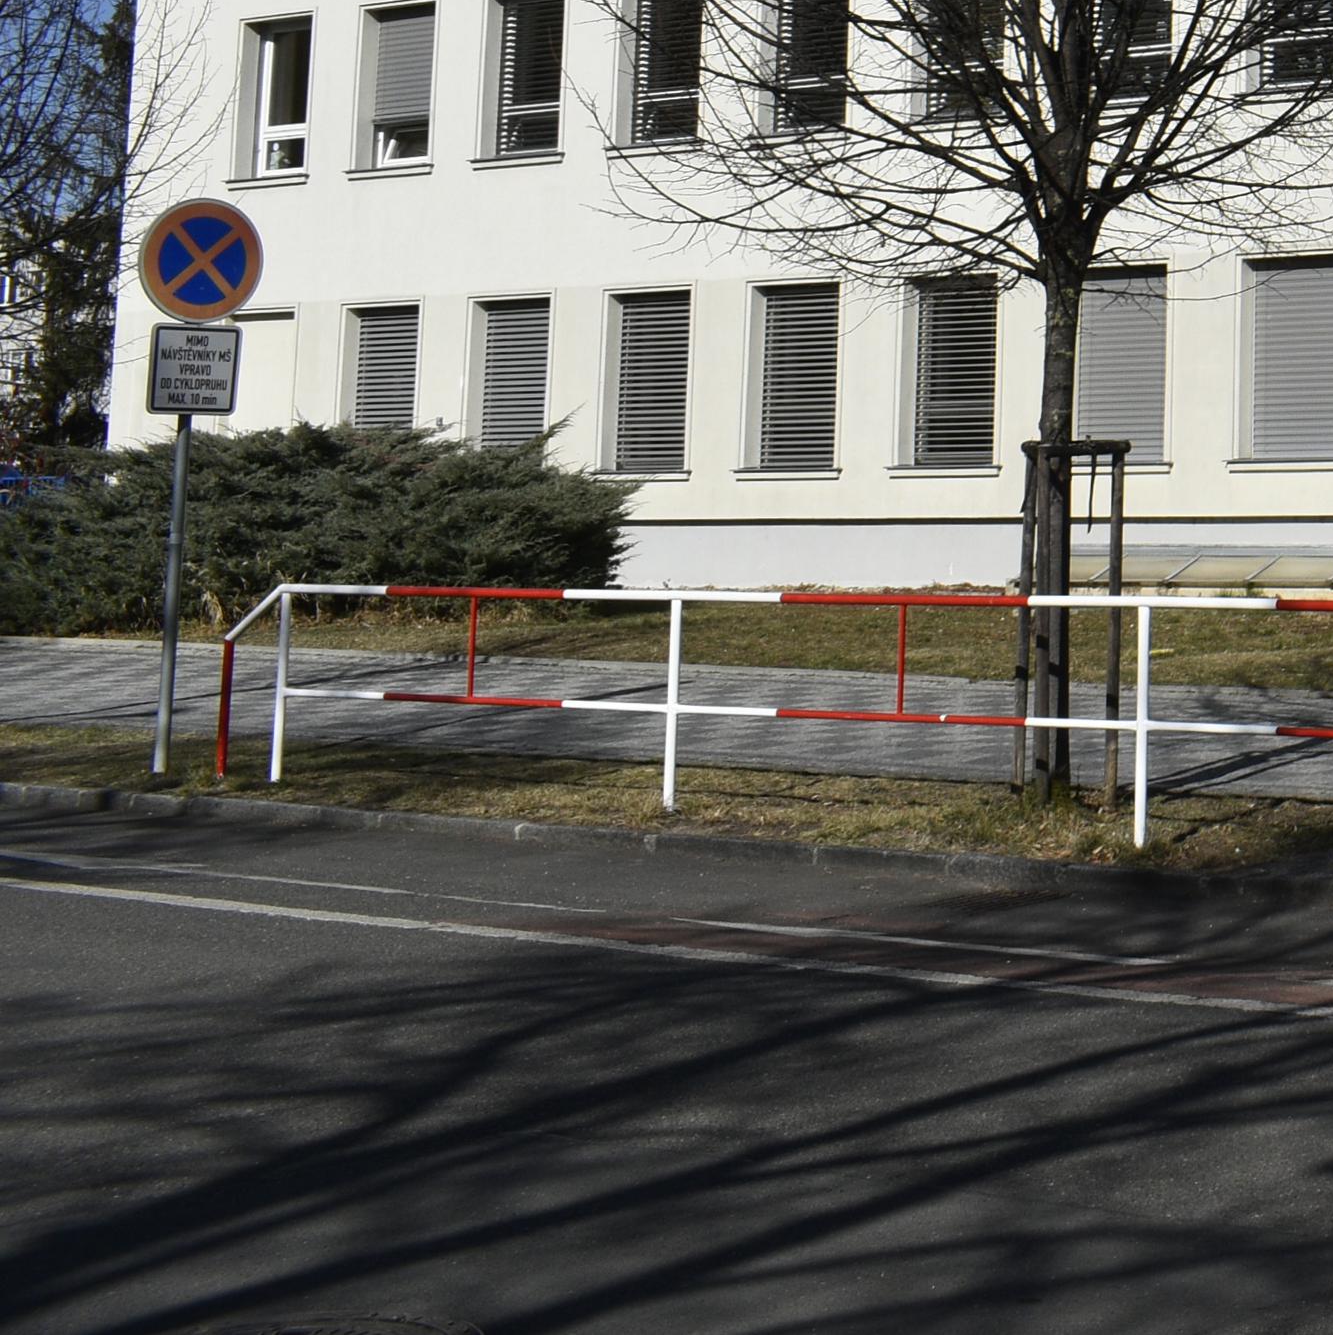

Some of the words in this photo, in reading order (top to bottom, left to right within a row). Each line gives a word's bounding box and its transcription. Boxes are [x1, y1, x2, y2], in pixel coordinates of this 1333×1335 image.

[186, 335, 209, 346] MIMO
[161, 346, 217, 362] NÁVŠTĚVNÍKY
[218, 348, 232, 362] MŠ
[179, 364, 212, 376] VPRAVO
[160, 377, 172, 389] OD
[174, 378, 228, 390] CYKLOPRUHU
[190, 393, 200, 405] 10
[201, 394, 217, 405] min
